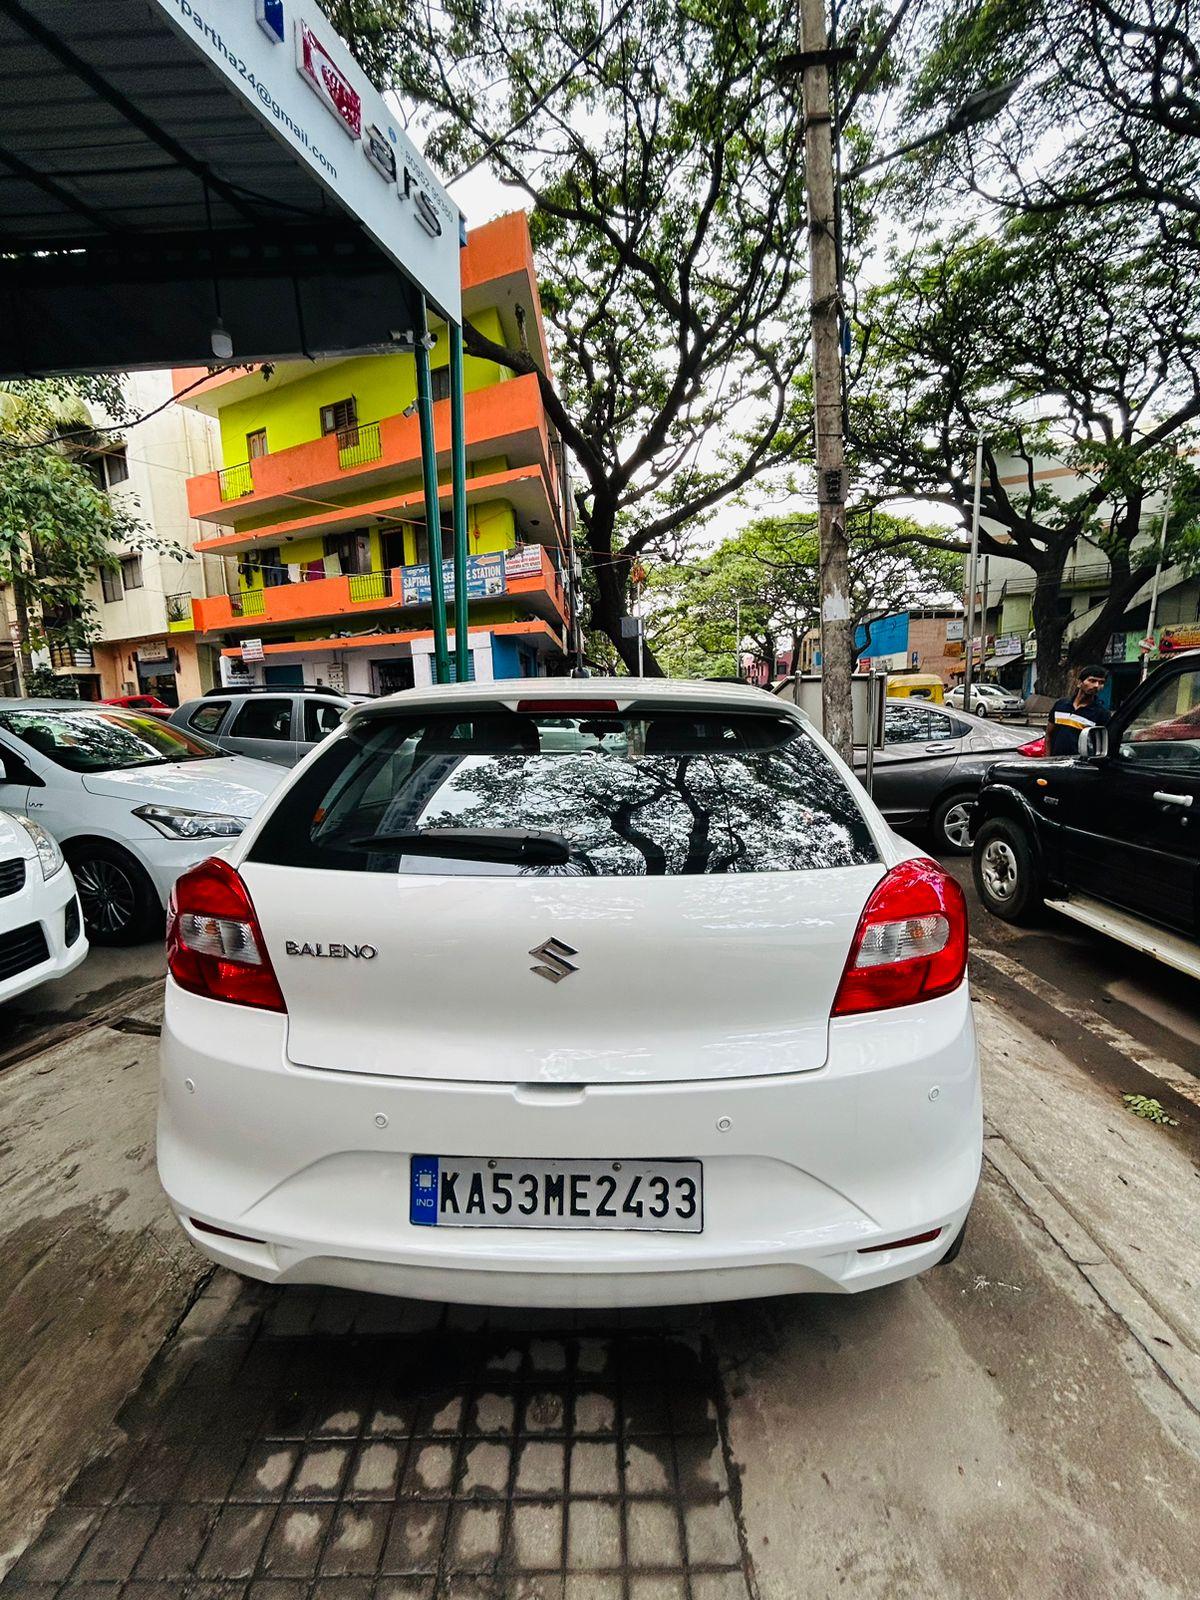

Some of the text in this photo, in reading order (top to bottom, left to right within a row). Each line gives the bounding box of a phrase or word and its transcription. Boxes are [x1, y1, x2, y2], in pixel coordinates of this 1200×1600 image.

[472, 565, 501, 579] STATION
[285, 940, 378, 960] BALENO
[416, 1199, 433, 1207] IND
[440, 1171, 697, 1219] KA53ME2433
